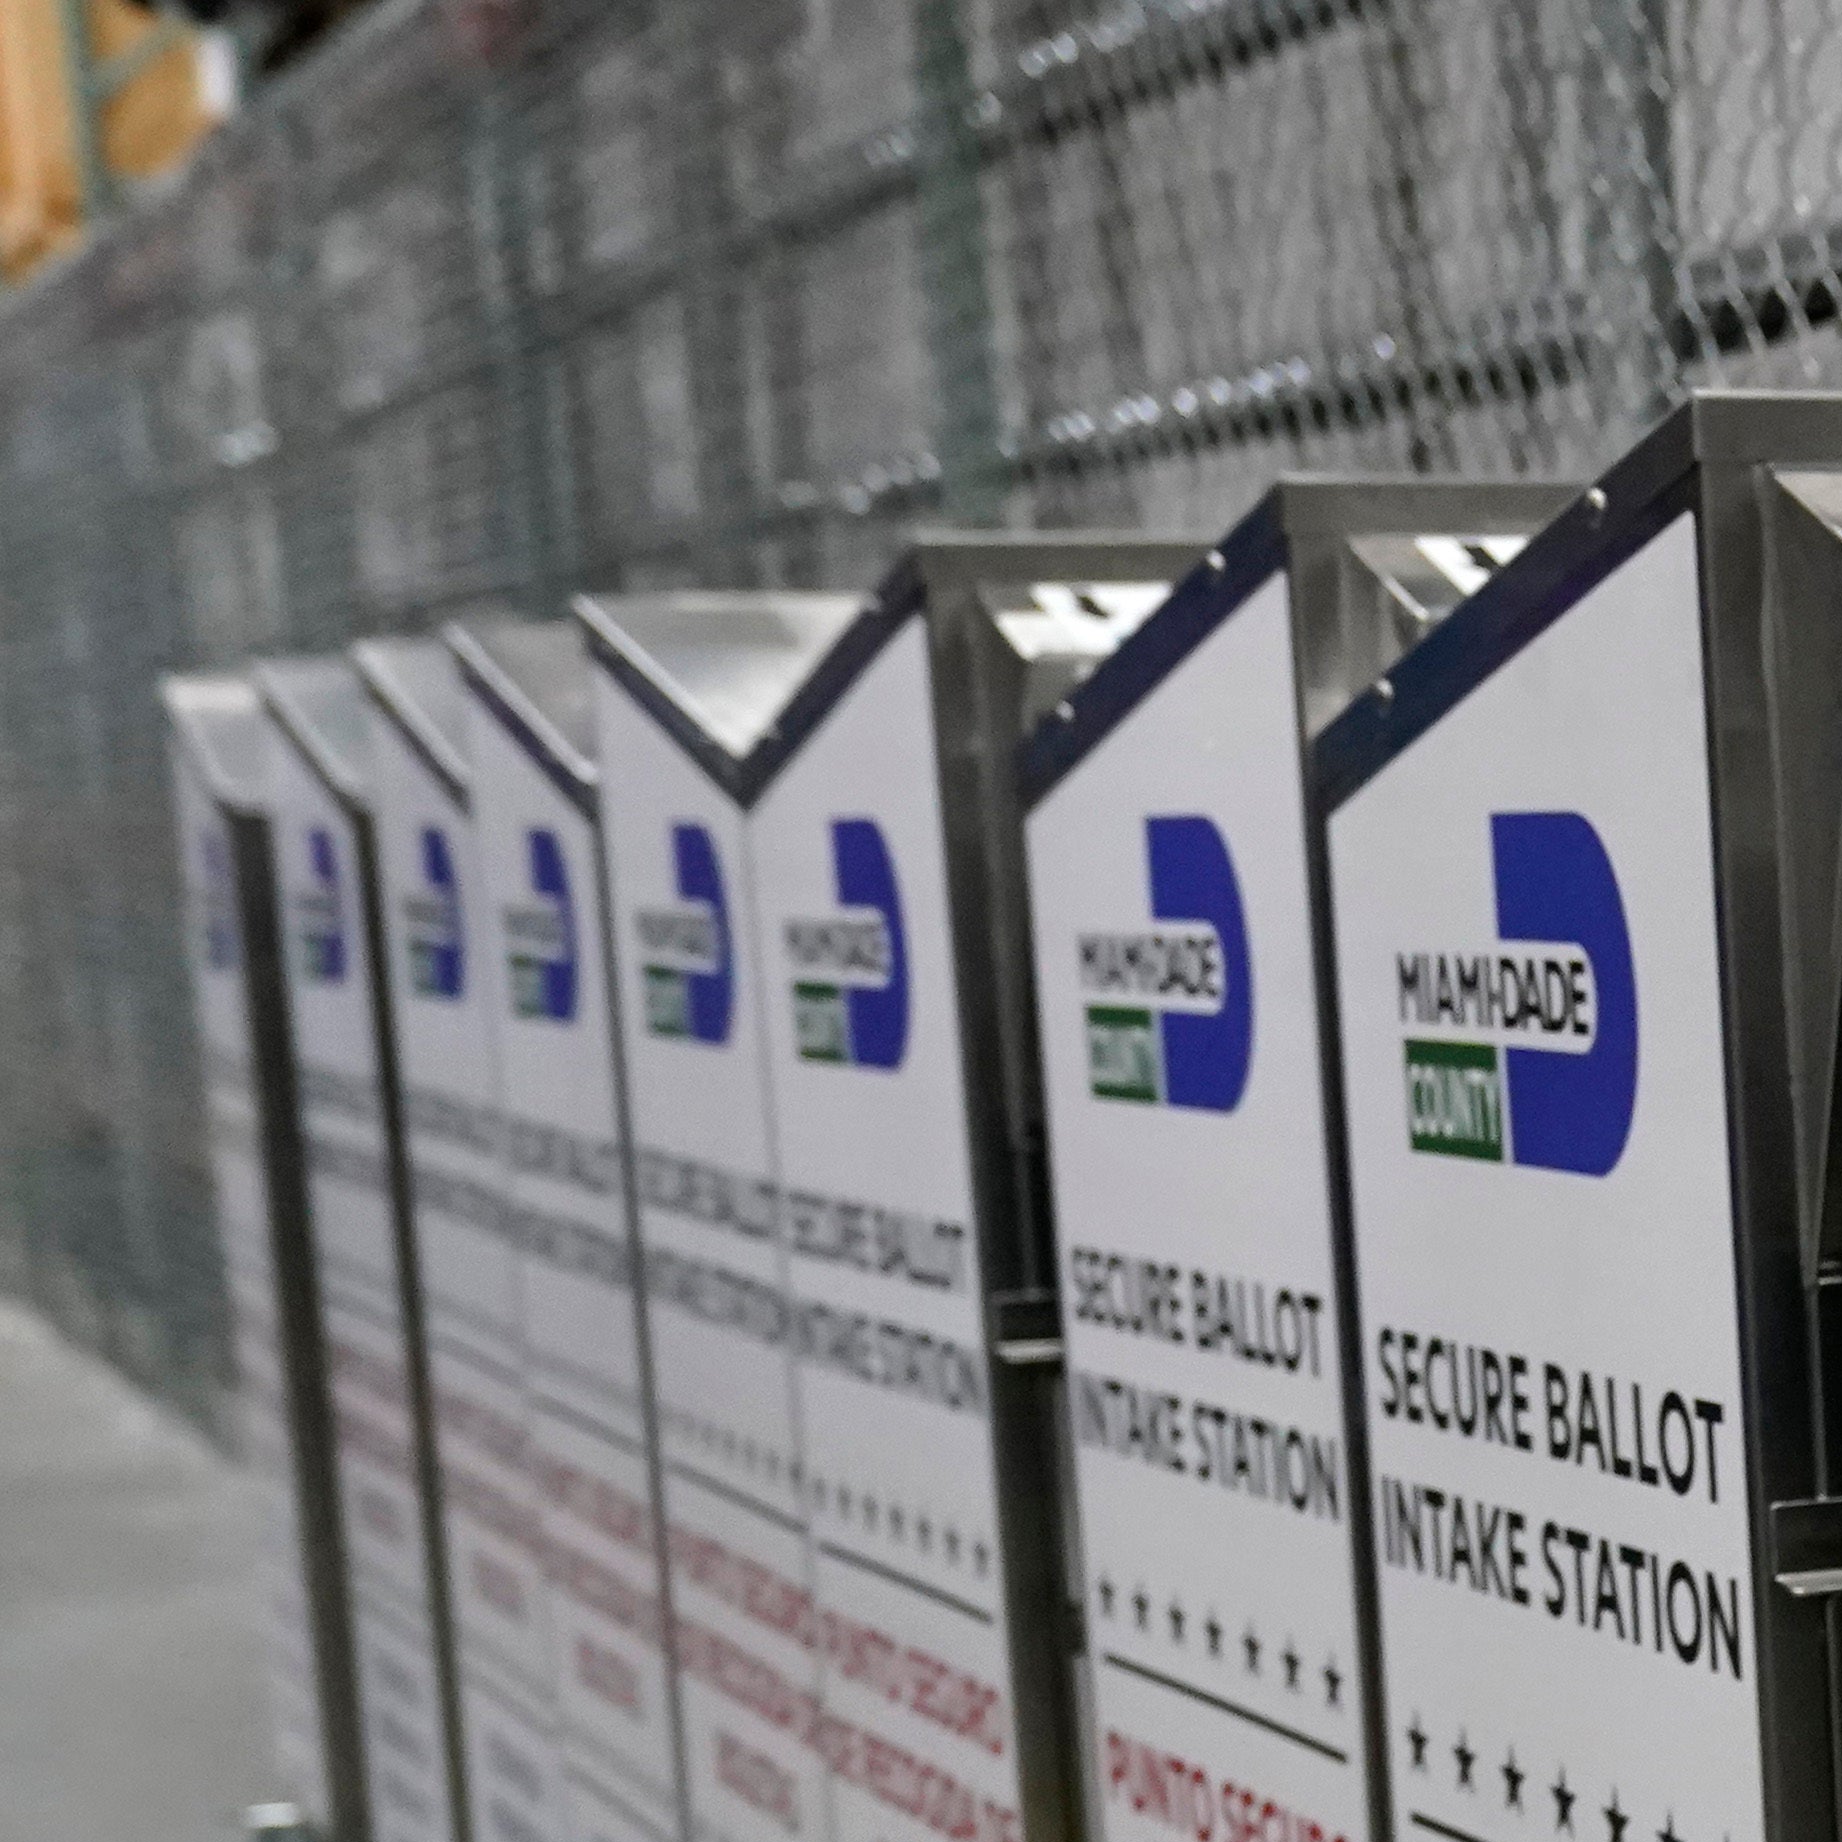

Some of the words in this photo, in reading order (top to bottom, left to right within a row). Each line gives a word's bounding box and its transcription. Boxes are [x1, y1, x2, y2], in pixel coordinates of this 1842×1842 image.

[1397, 952, 1590, 1036] MIAMI-DADE
[1409, 1064, 1501, 1143] COUNTY
[1380, 1328, 1532, 1451] SECURE
[1544, 1363, 1723, 1502] BALLOT
[1379, 1474, 1530, 1606] INTAKE
[1542, 1522, 1741, 1679] STATION
